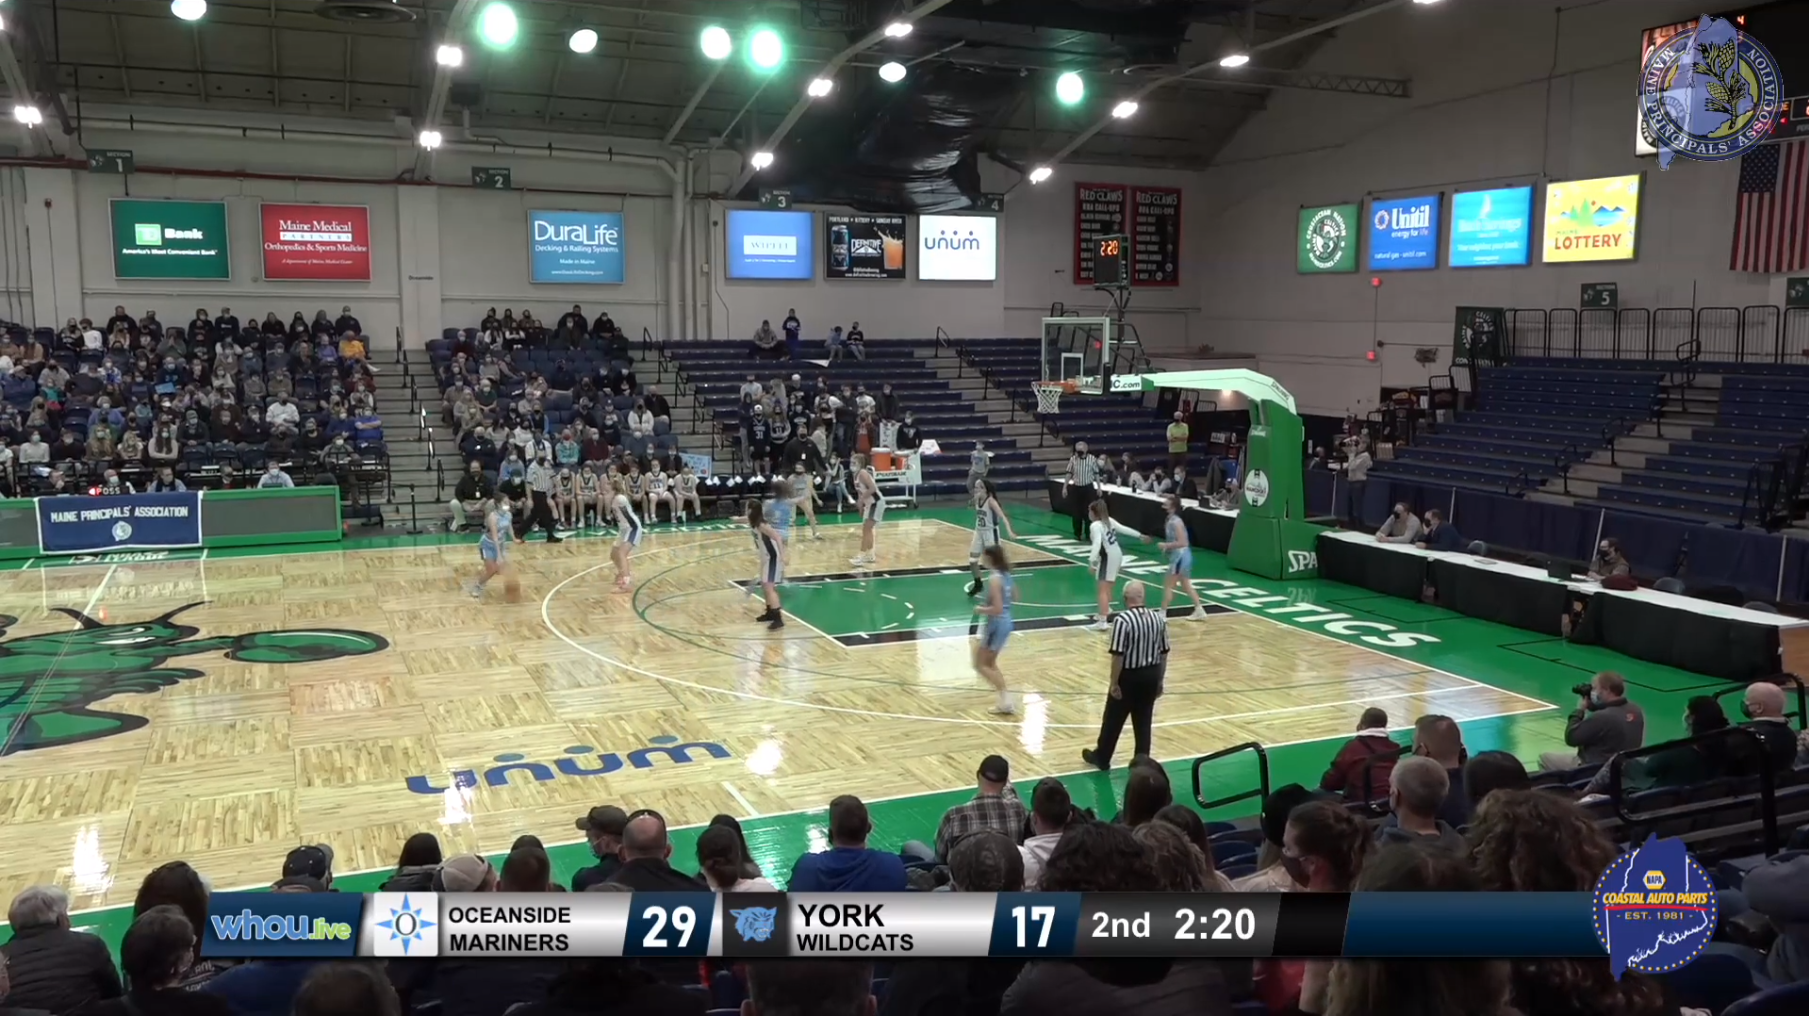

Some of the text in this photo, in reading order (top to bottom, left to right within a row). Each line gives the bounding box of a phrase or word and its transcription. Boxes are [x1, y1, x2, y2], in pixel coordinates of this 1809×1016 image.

[115, 158, 123, 172] 1
[494, 176, 504, 188] 2
[777, 195, 787, 208] 3
[1080, 188, 1123, 203] RED CLAWS
[1136, 191, 1178, 205] RED CLAWS
[991, 200, 1000, 211] 4
[1391, 204, 1430, 230] Unitil
[279, 219, 352, 232] Maine Medical
[164, 227, 204, 240] Bank
[534, 220, 618, 246] DuraLife
[1391, 231, 1410, 239] energy
[264, 242, 367, 253] Orthopedics & Sports Medicine
[924, 232, 980, 250] unum
[1100, 240, 1119, 256] 2:20
[1554, 233, 1622, 250] LOTTERY
[535, 245, 562, 253] Decking
[569, 245, 592, 254] Railing
[592, 246, 619, 254] Systems
[1601, 291, 1610, 305] 5
[1110, 379, 1140, 389] C.com
[96, 487, 121, 495] POSS
[50, 505, 189, 523] MAINE PRINCIPALS' ASSOCIATION
[1016, 534, 1442, 648] MANE CELTICS
[405, 735, 732, 794] unum
